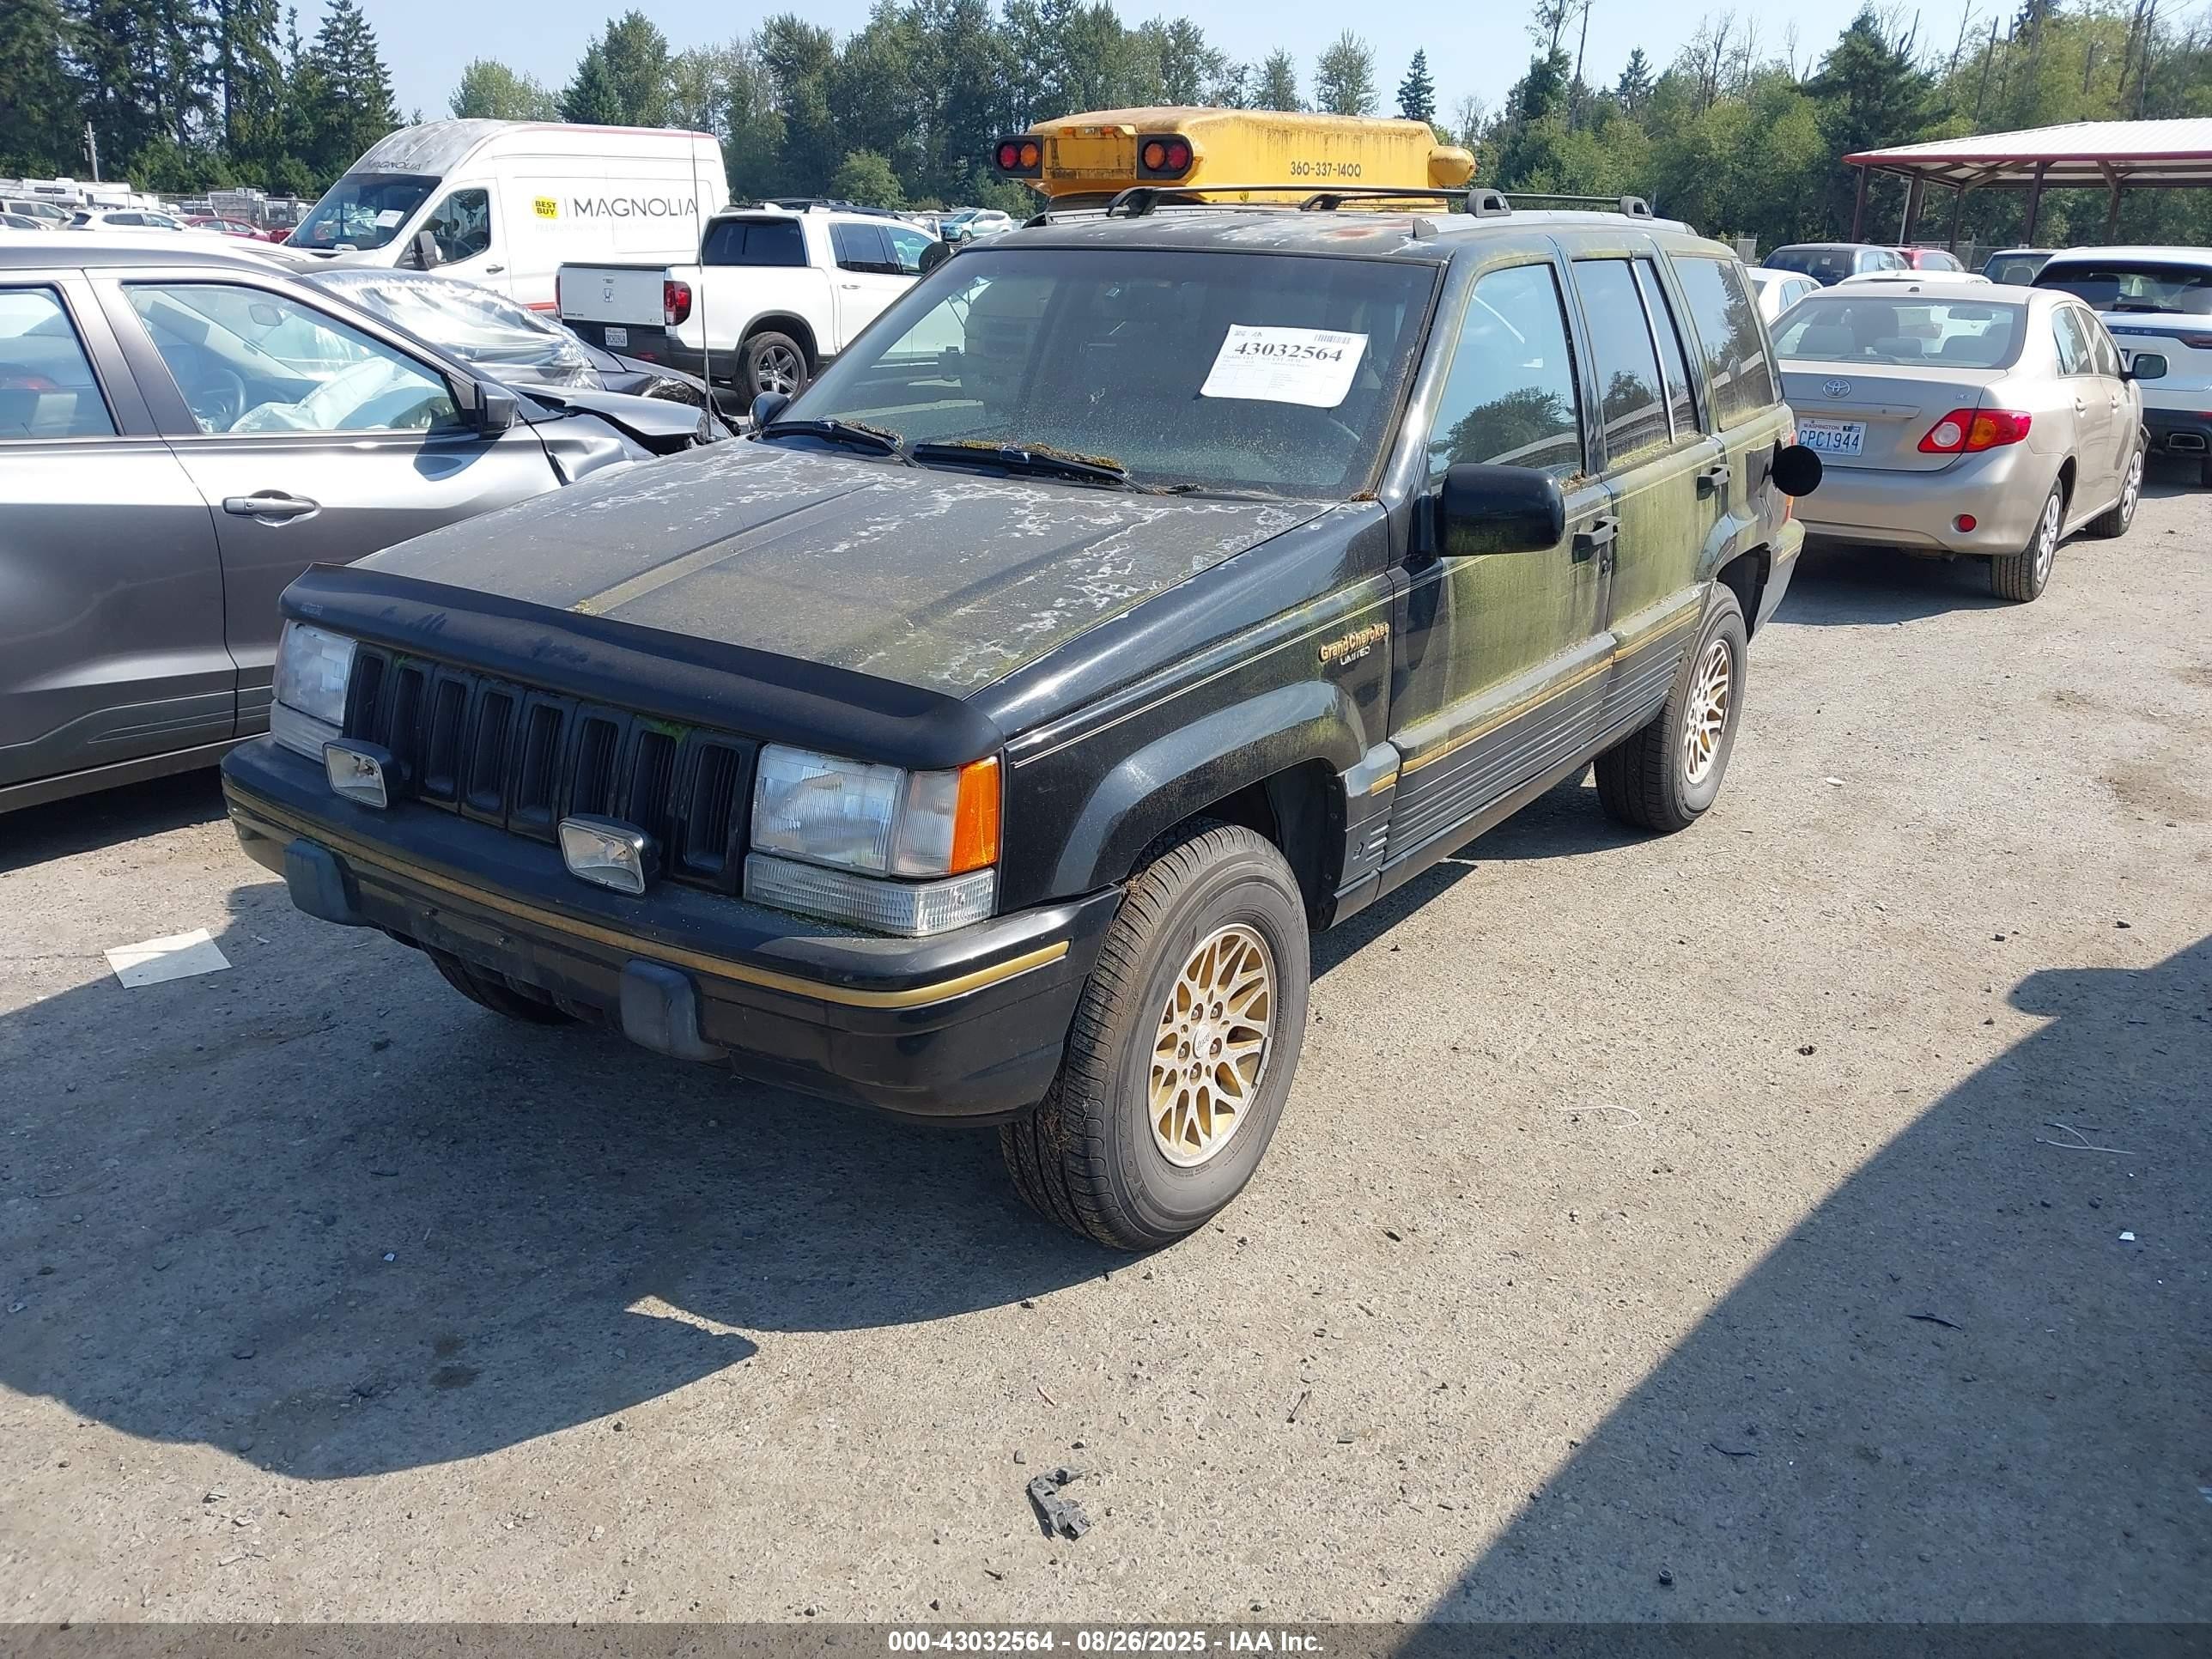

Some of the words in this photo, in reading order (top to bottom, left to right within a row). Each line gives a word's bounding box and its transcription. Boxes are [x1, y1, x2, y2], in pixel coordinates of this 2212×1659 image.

[1291, 161, 1362, 178] 360-337-1400
[535, 200, 556, 209] BEST
[537, 207, 556, 216] BUY
[574, 198, 698, 217] MAGNOLIA
[1234, 342, 1344, 362] 43032564
[1798, 429, 1861, 451] CPC1944
[1319, 635, 1349, 661] Grand
[1348, 623, 1390, 649] Cherokee
[1340, 645, 1371, 665] LIMITED
